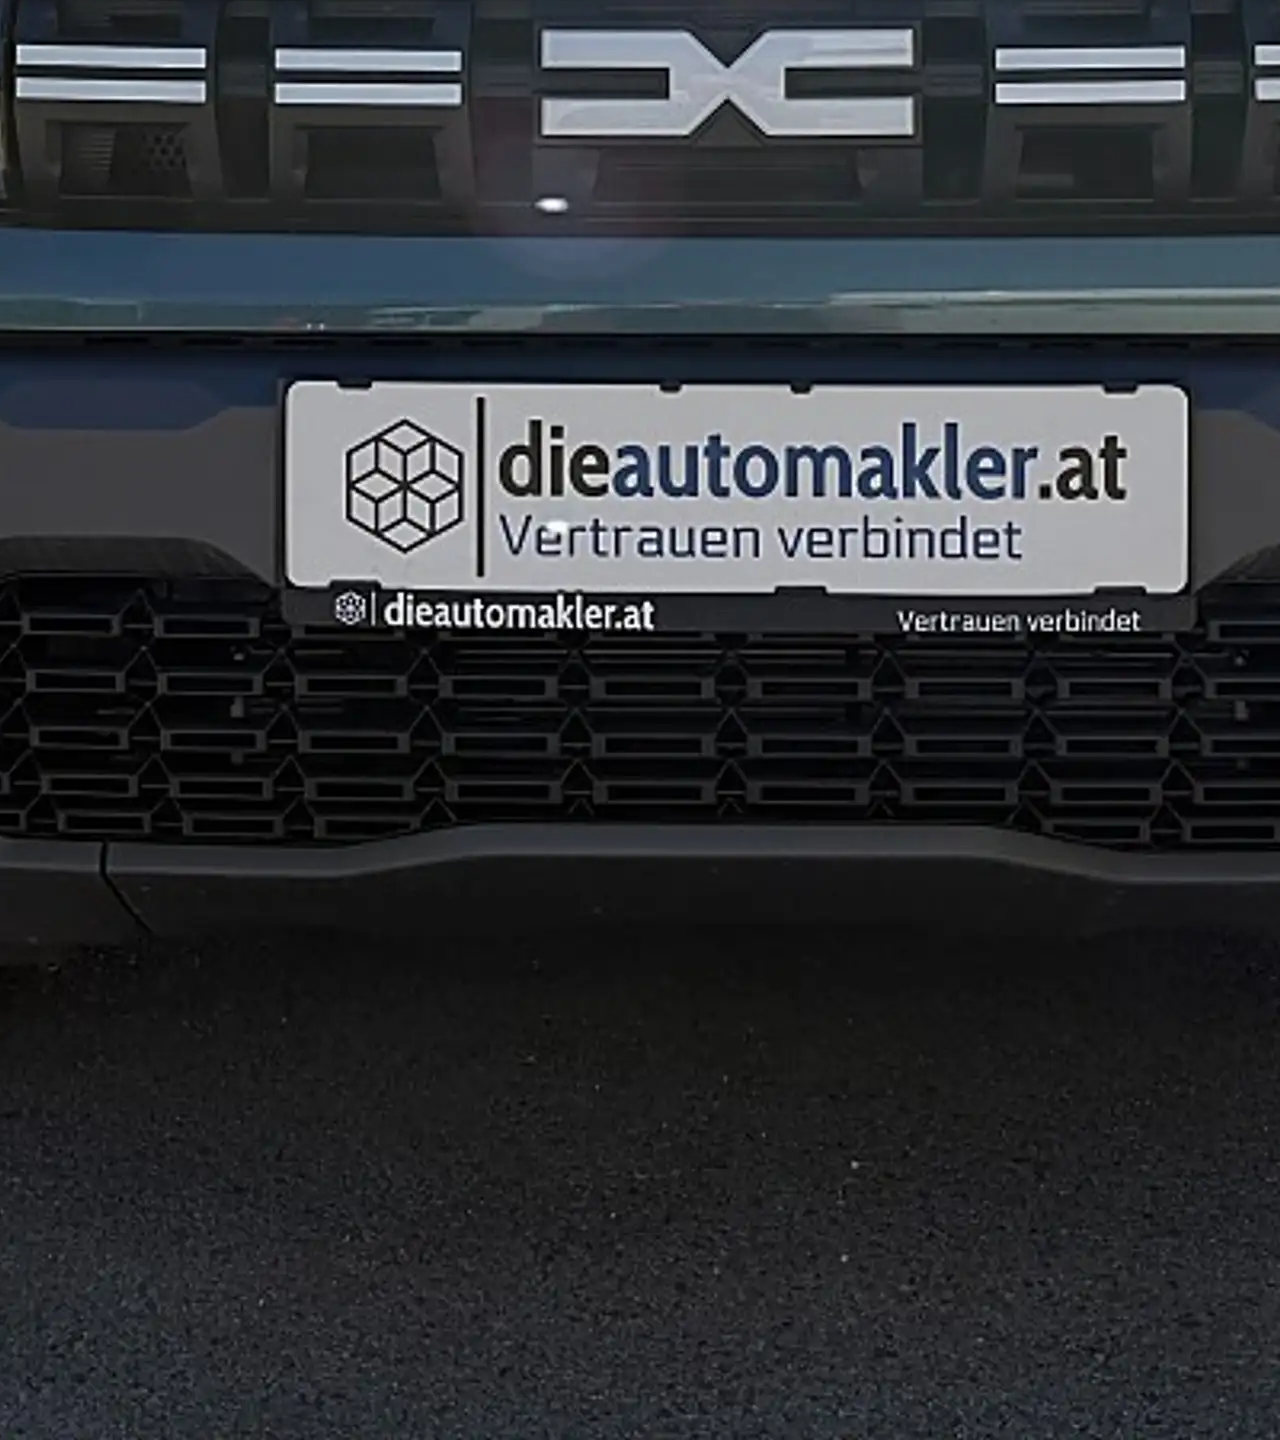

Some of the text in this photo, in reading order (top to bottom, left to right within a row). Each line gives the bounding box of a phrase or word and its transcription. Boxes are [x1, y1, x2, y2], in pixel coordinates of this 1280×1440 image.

[498, 419, 1128, 501] dieautomakler.at
[499, 513, 1024, 560] Vertrauen verbindet
[383, 592, 656, 631] dieautomakler.at
[897, 608, 1141, 632] Vertrauen verbindet
